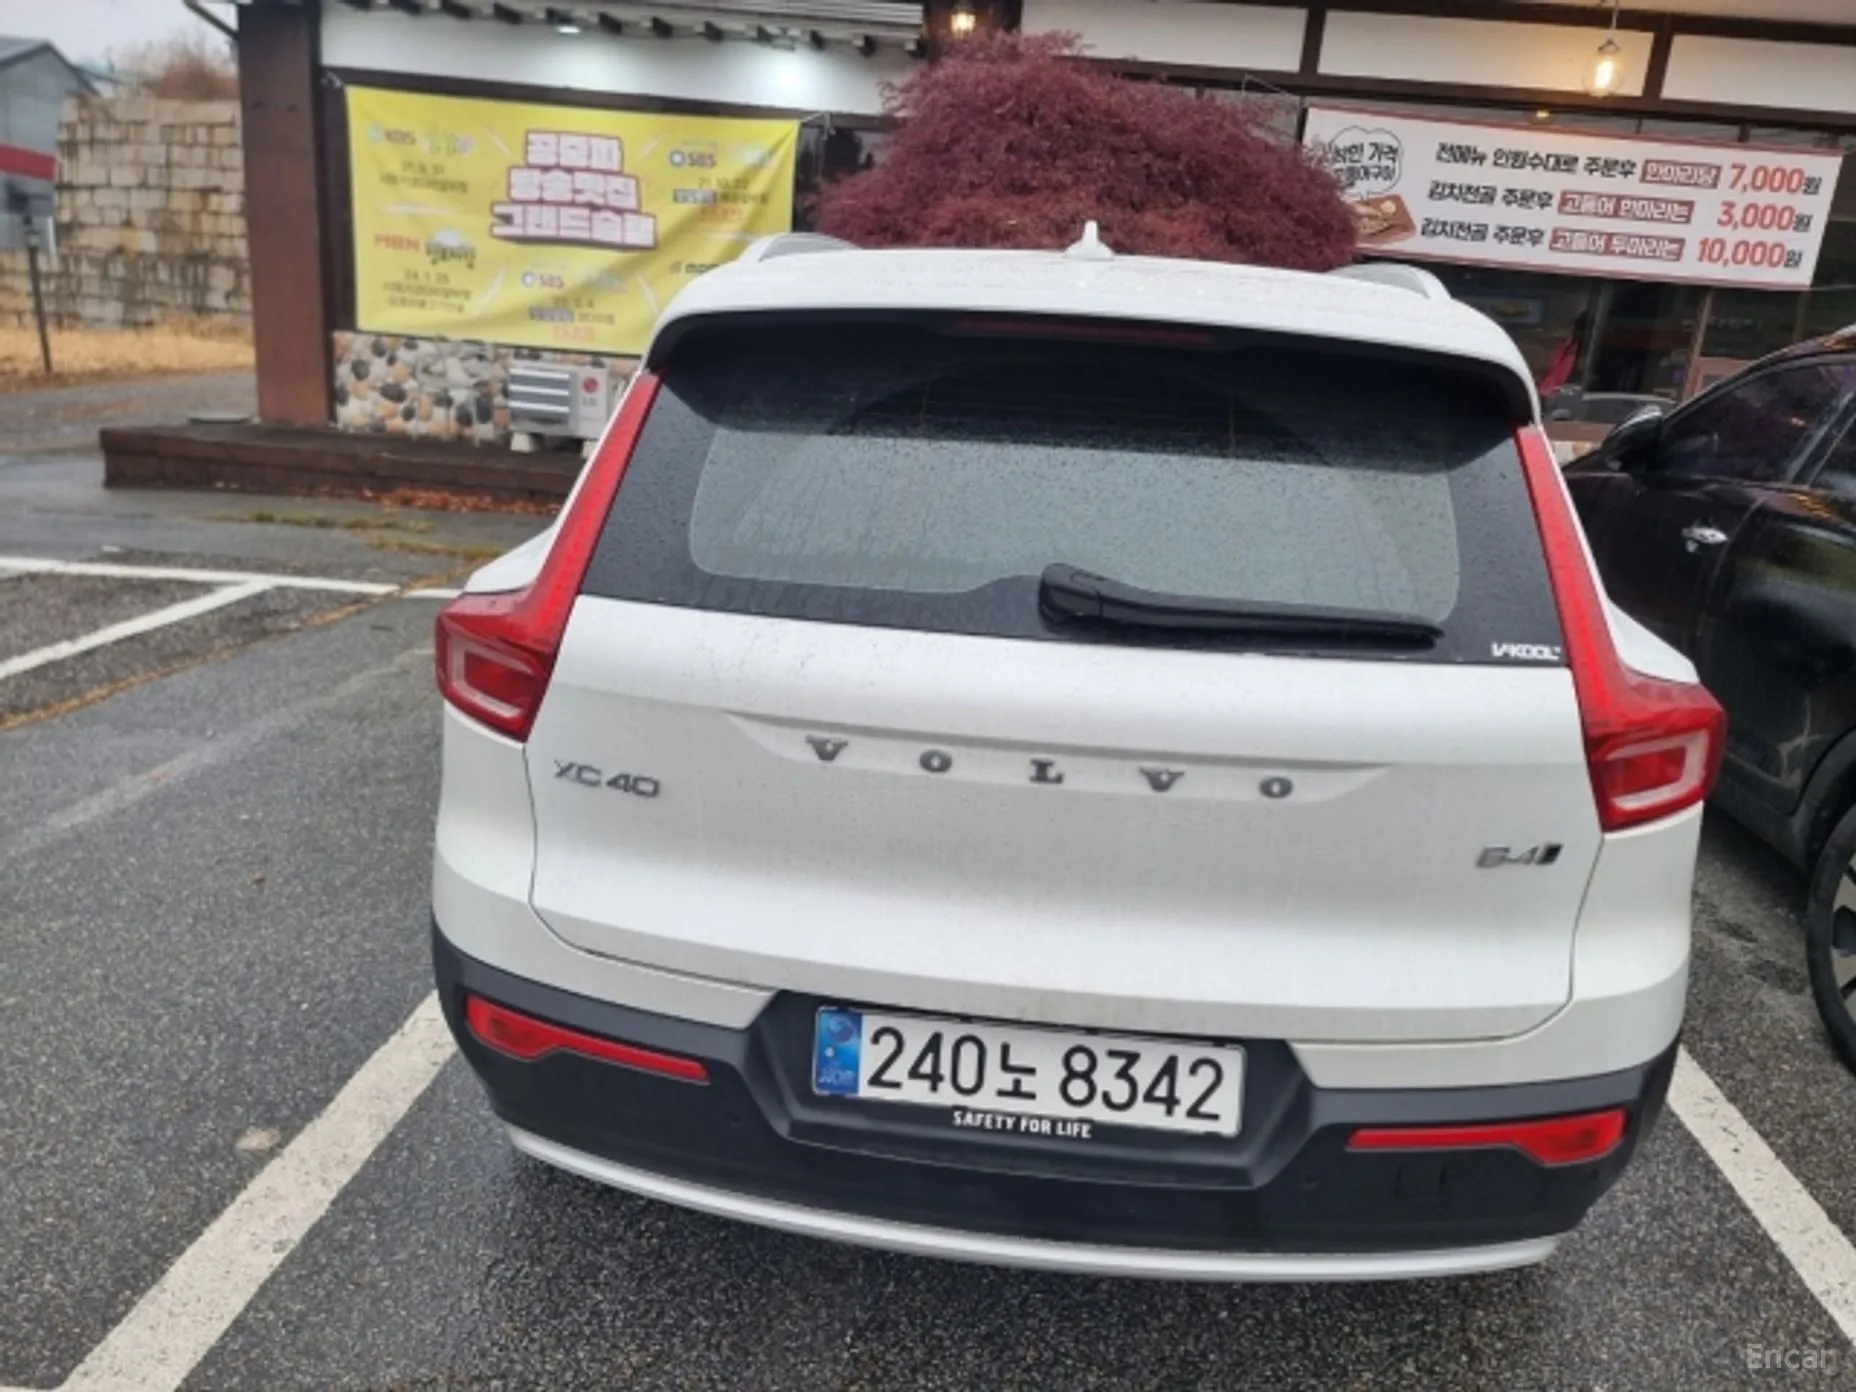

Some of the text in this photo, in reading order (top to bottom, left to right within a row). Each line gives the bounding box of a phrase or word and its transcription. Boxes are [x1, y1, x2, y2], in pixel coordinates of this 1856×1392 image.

[1492, 148, 1579, 174] 인원수대로
[1584, 155, 1637, 178] 주문후
[1729, 163, 1823, 195] 7,000원
[1428, 180, 1498, 206] 김치전골
[1502, 187, 1554, 211] 주문후
[1717, 201, 1813, 233] 3,000원
[1420, 217, 1489, 242] 김치전골
[1493, 224, 1545, 248] 주문후
[1697, 237, 1804, 268] 10,000원
[806, 735, 1294, 799] VOLVO
[867, 1026, 1225, 1122] 240노 8342
[953, 1110, 1092, 1138] SAFETY FOR LIFE
